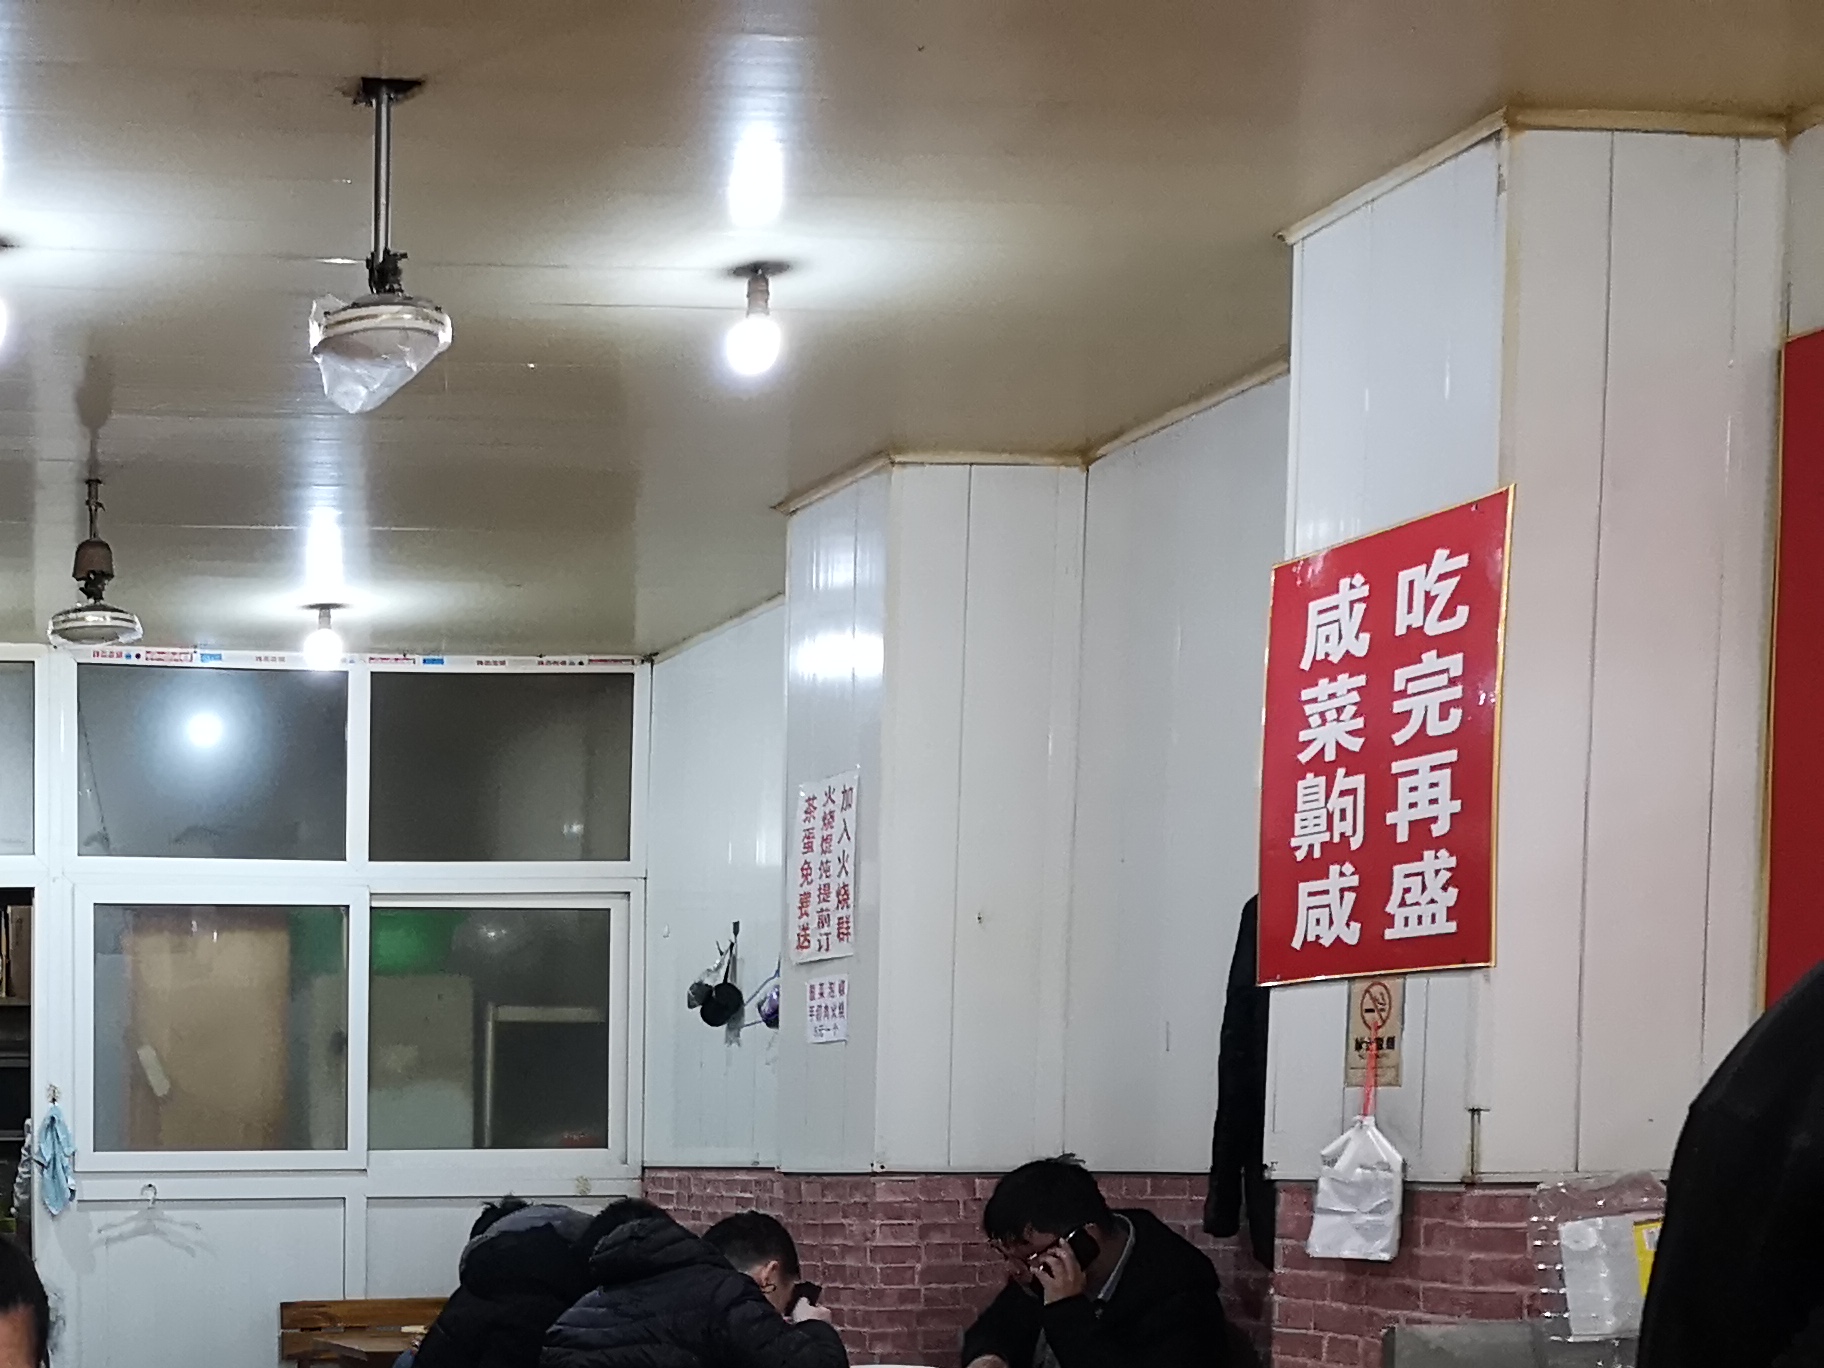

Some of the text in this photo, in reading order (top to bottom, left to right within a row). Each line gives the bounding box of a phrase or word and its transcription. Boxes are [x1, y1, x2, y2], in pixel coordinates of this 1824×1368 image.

[795, 793, 818, 951] 茶蛋免费送
[837, 784, 854, 944] 加入火烧群
[1289, 572, 1372, 952] 咸菜齁咸
[1383, 546, 1471, 941] 吃完再盛
